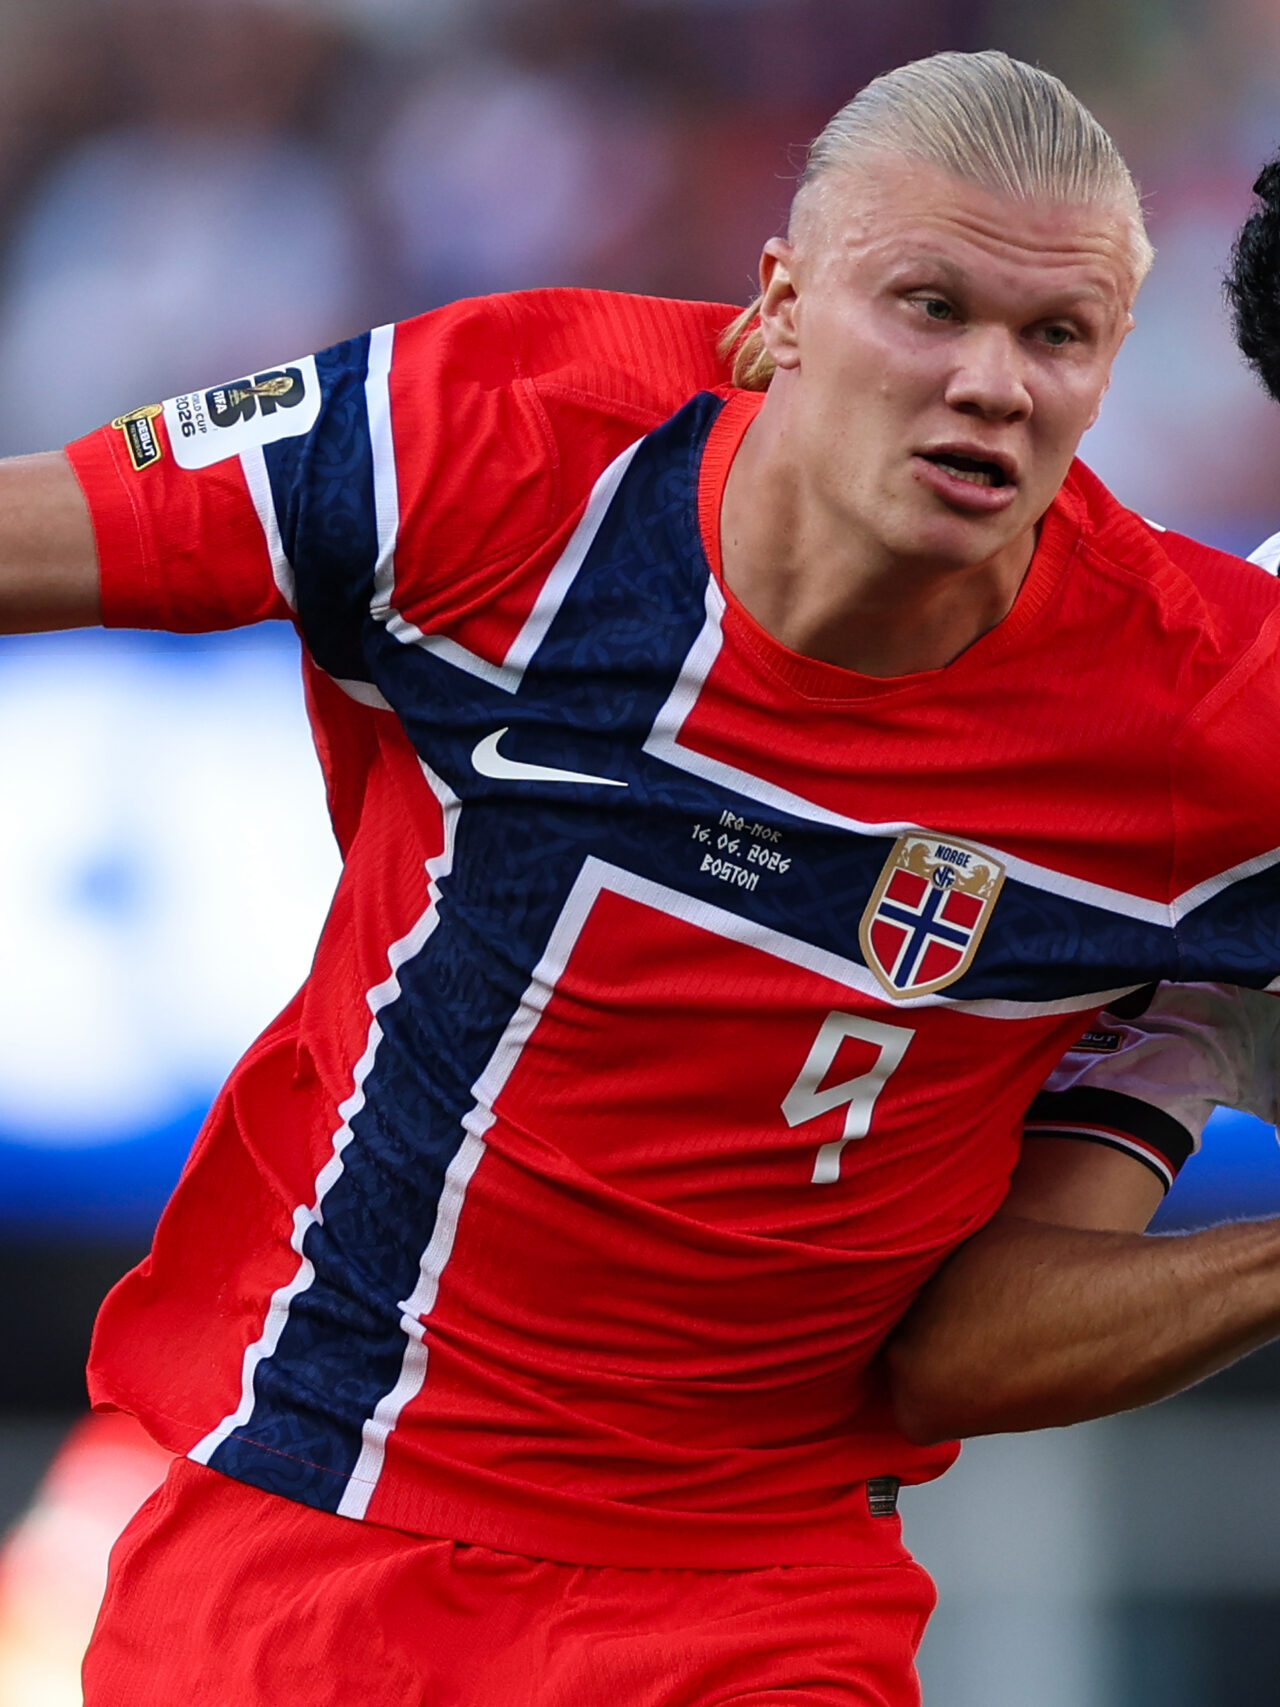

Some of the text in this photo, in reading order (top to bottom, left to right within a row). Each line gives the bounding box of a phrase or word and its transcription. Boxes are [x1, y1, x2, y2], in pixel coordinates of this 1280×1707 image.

[175, 395, 196, 437] 2026
[212, 391, 226, 414] FIFA
[136, 418, 156, 457] DEBUT
[195, 412, 208, 434] CUP
[718, 809, 783, 843] IRQ-NOR
[699, 853, 760, 892] BOSTON
[934, 844, 972, 868] NORGE
[1081, 1032, 1116, 1042] BUT
[780, 1010, 916, 1185] 9
